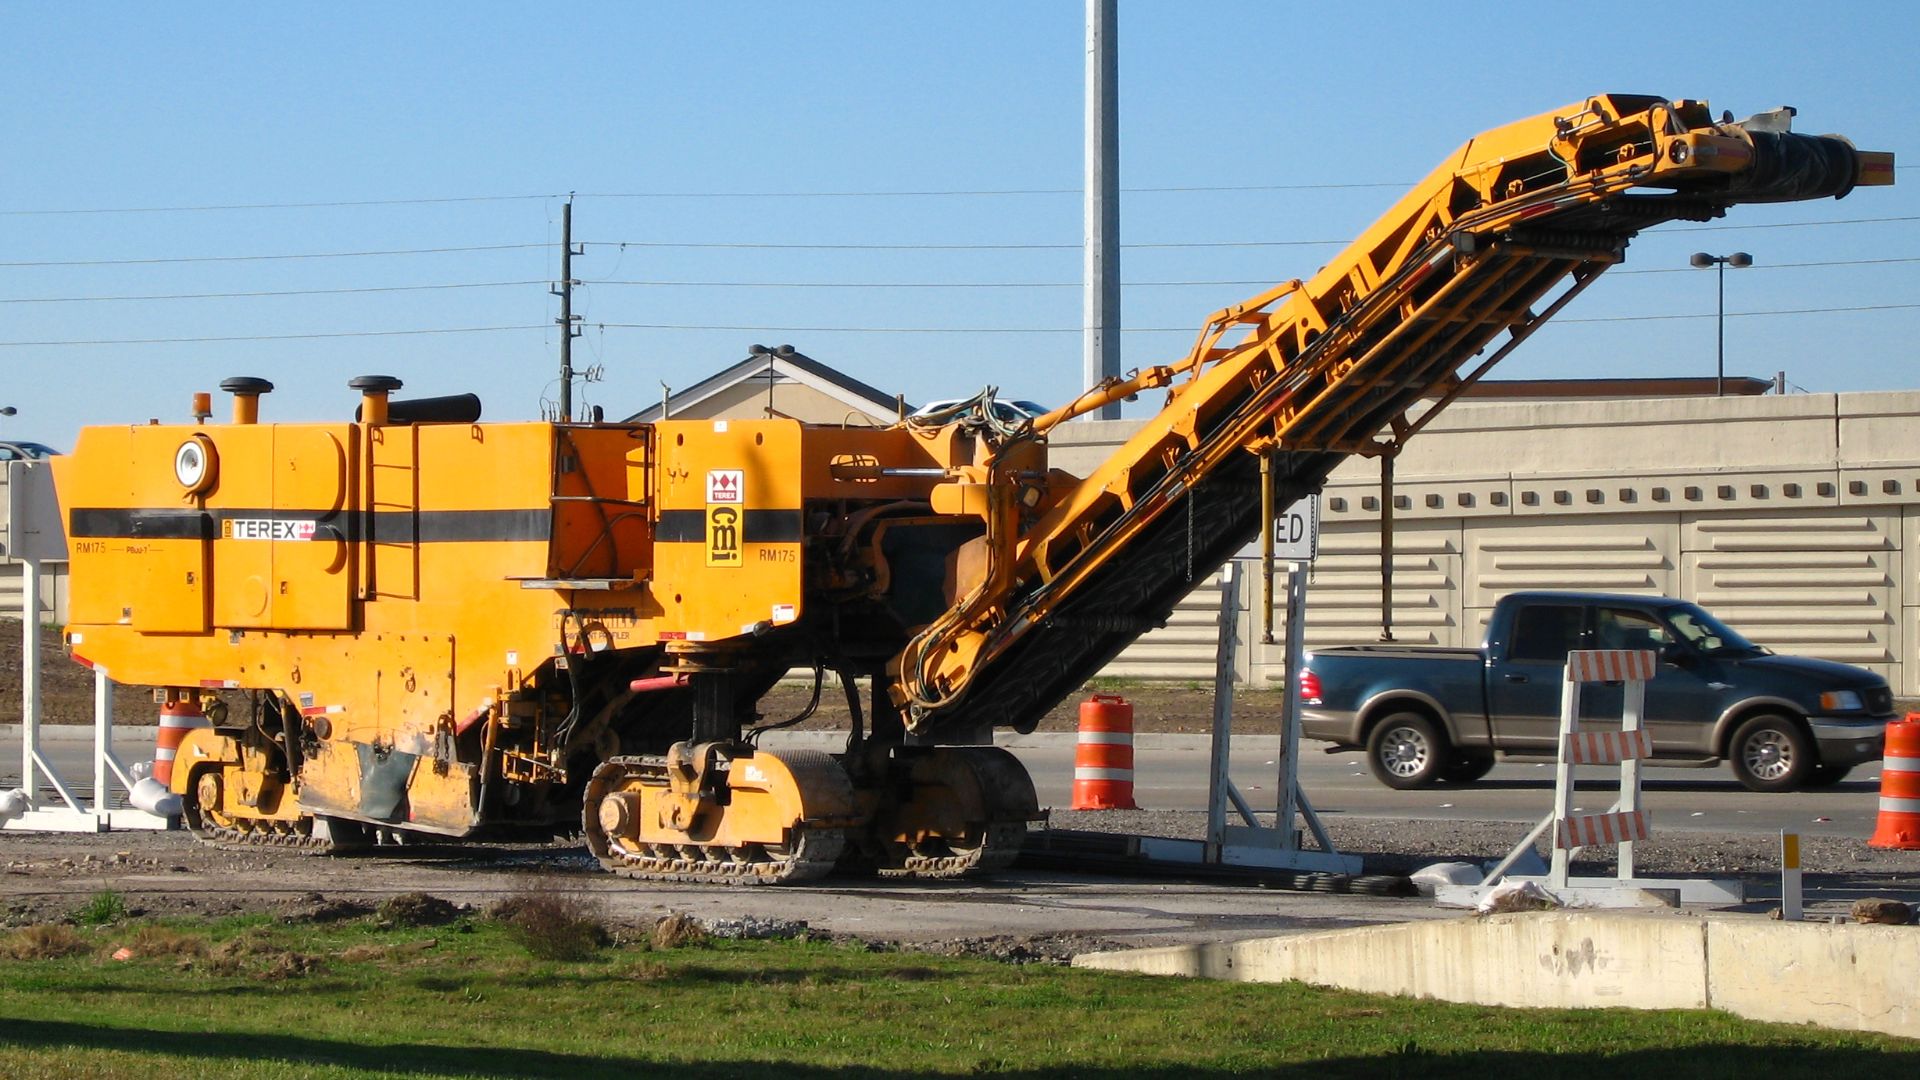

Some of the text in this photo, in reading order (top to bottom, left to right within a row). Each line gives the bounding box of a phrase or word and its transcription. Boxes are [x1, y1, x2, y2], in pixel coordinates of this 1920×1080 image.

[714, 491, 736, 500] TEREX
[235, 520, 296, 539] TEREX
[76, 542, 106, 554] RM175
[759, 548, 796, 562] RM175
